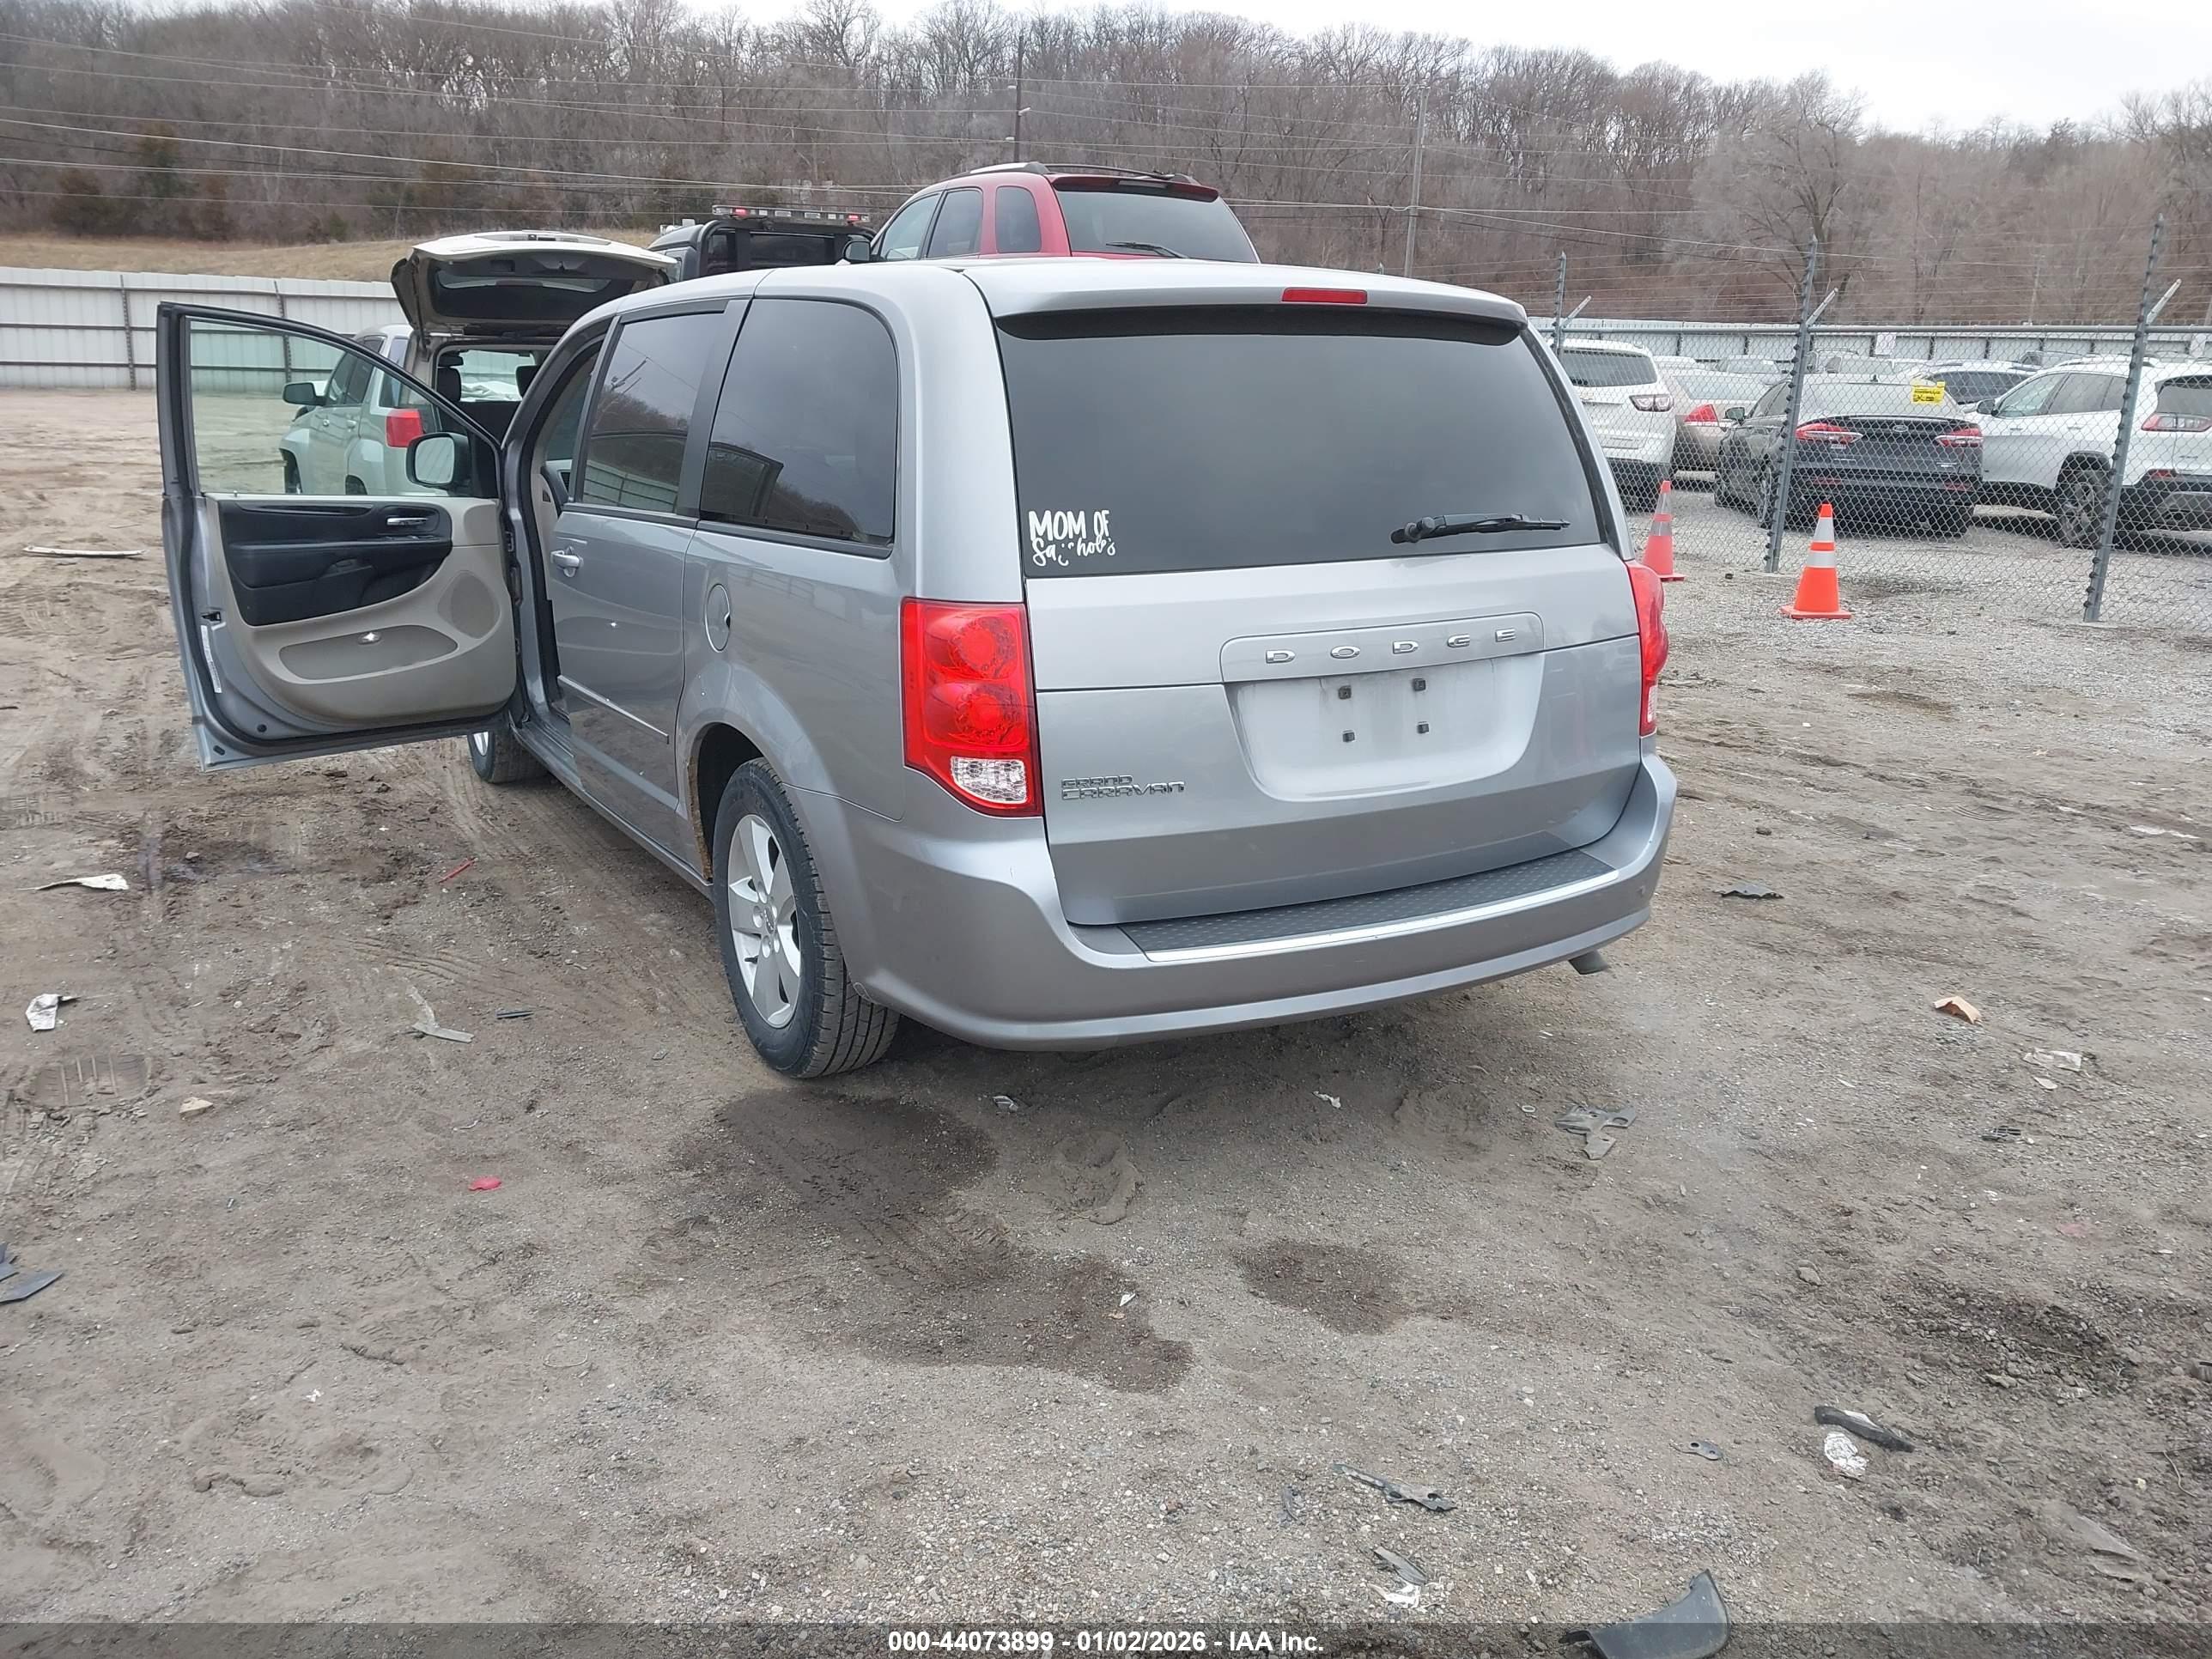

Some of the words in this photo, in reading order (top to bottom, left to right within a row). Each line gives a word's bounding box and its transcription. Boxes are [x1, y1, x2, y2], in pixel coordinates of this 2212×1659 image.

[1029, 510, 1086, 541] MOM
[1094, 510, 1109, 537] OF
[1265, 628, 1517, 665] DODGE
[1061, 775, 1133, 789] GRAND
[1061, 781, 1185, 800] CARAVAN
